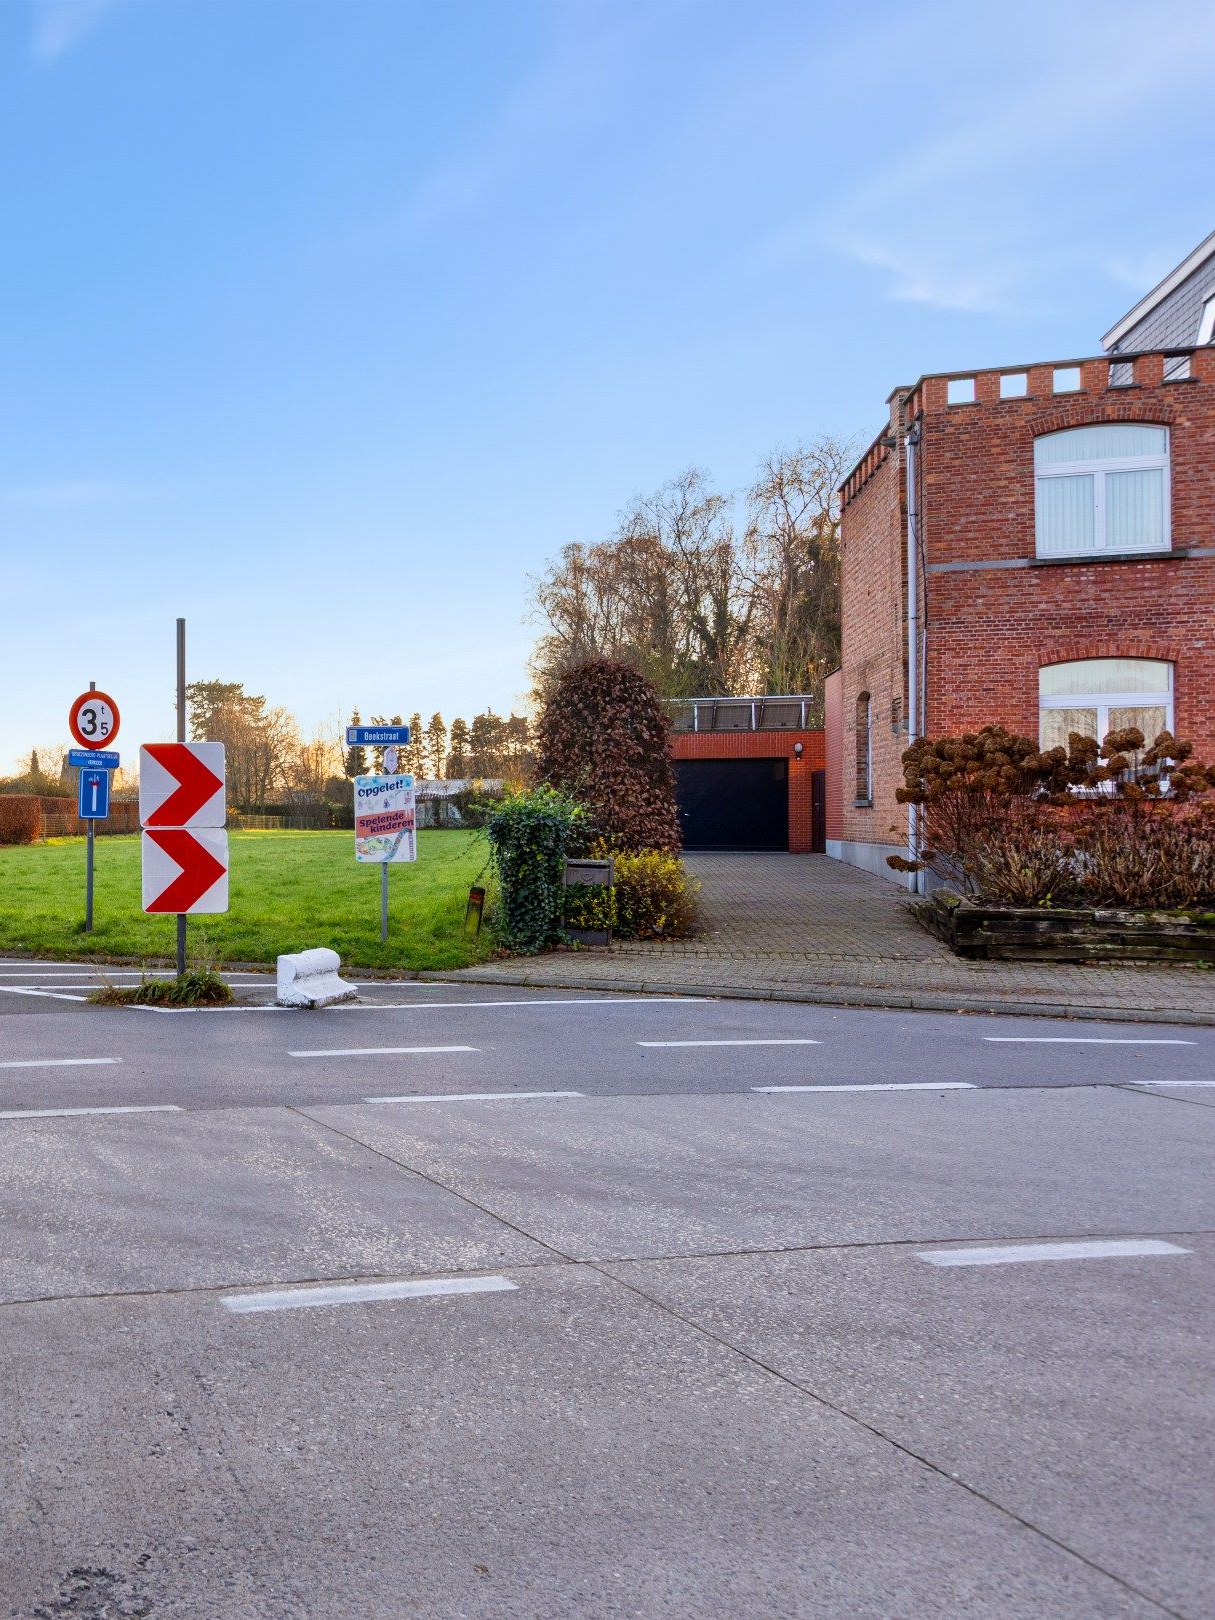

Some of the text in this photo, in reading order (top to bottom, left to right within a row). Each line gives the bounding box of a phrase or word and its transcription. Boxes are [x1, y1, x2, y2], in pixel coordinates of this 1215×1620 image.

[81, 708, 97, 735] 3
[364, 731, 400, 741] Beekstraat
[358, 780, 404, 798] Opgelet!
[359, 812, 404, 828] Spelende
[370, 819, 414, 834] kinderen
